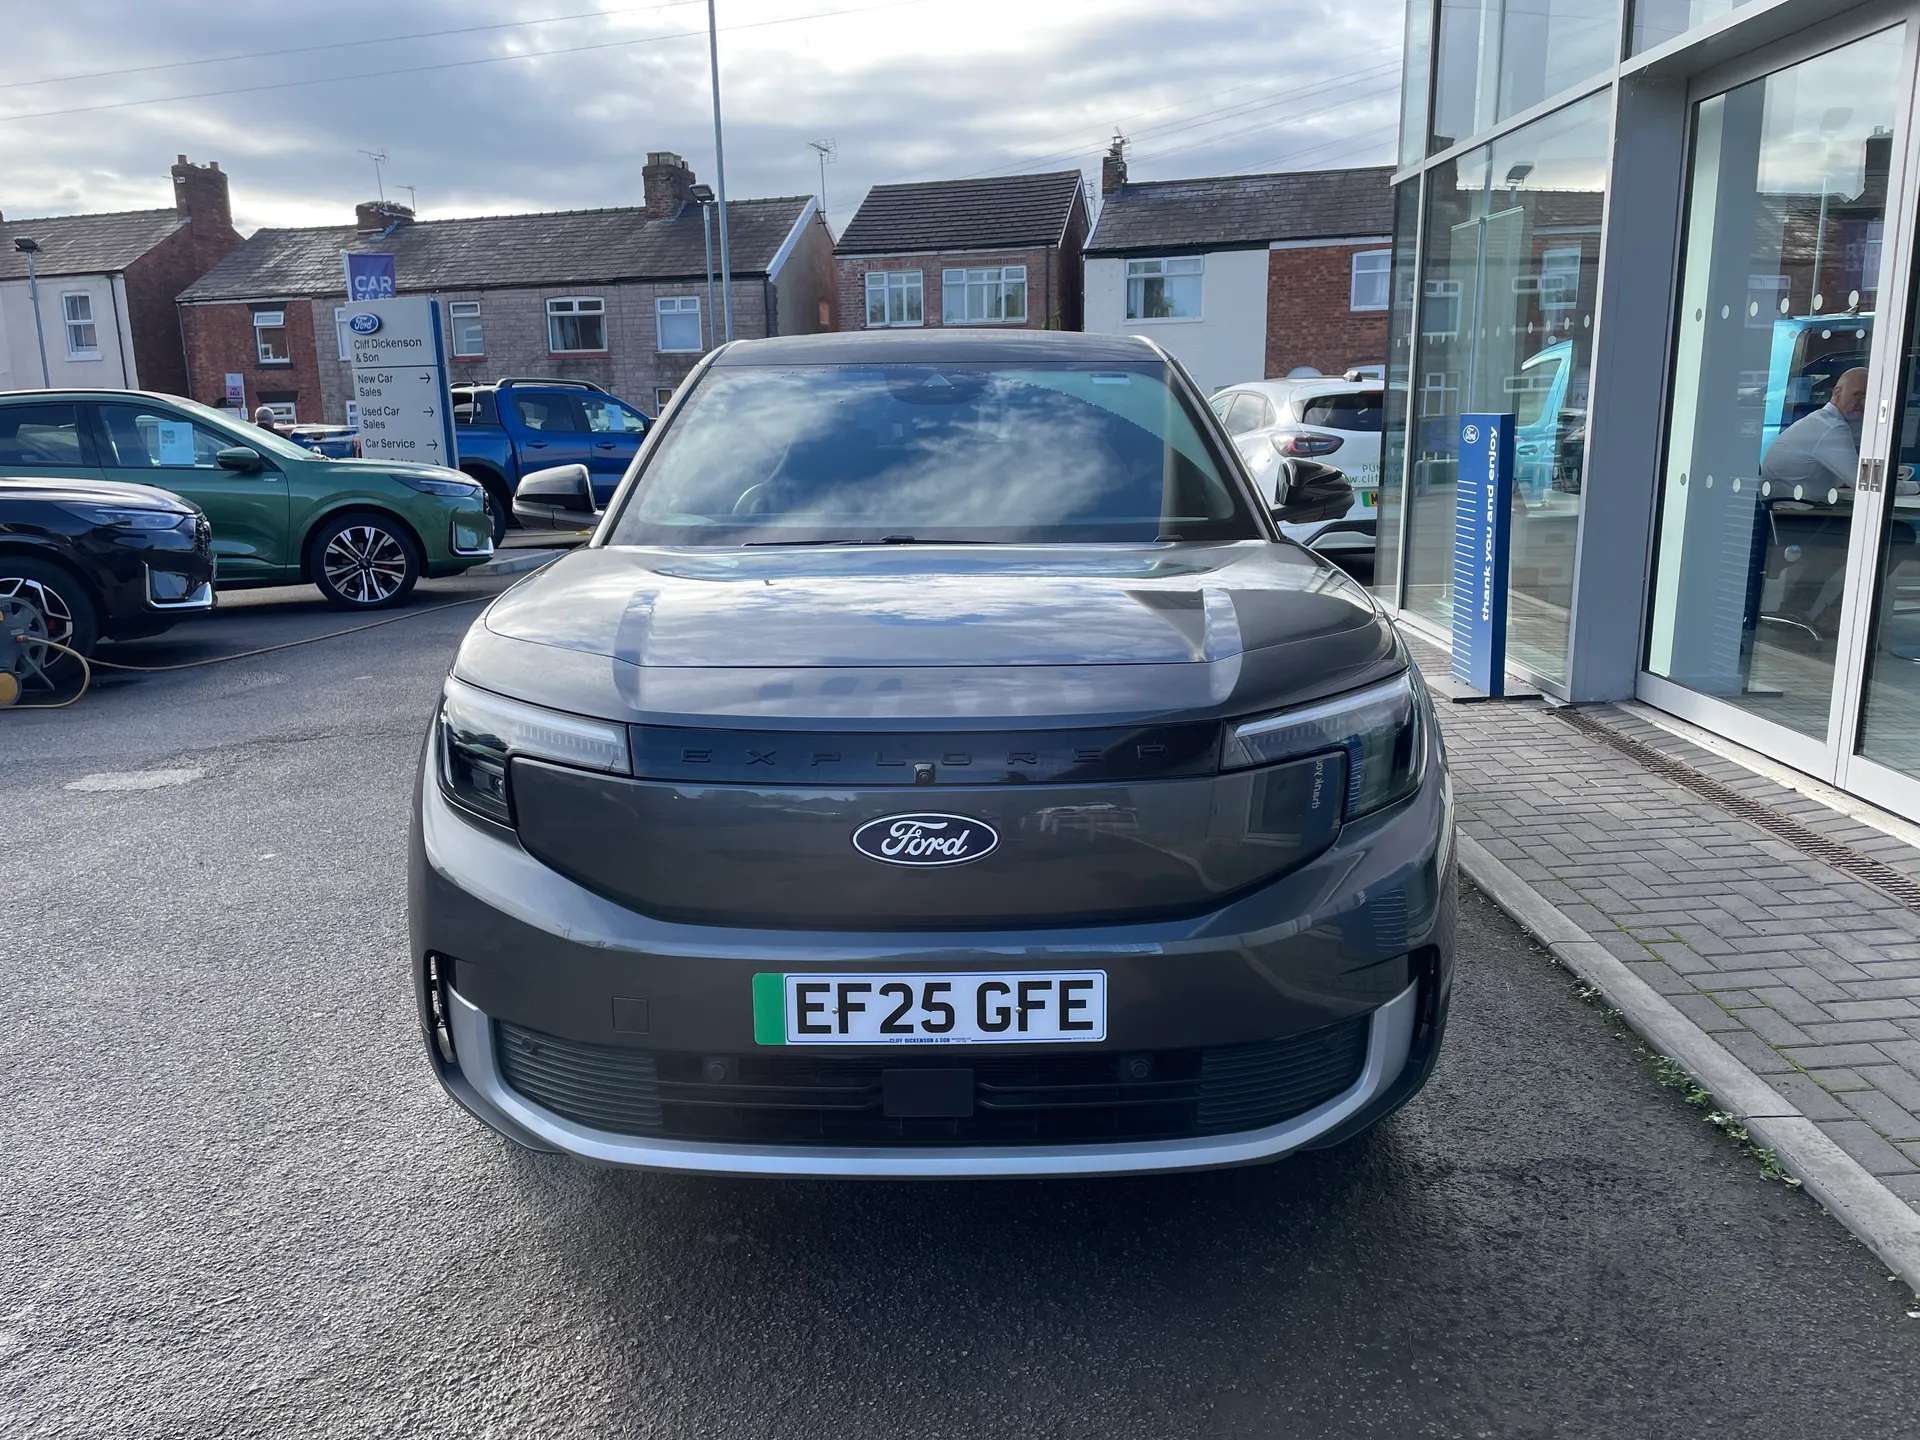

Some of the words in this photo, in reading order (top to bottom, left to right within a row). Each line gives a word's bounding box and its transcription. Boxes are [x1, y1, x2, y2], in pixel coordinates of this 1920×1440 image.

[354, 276, 392, 292] CAR
[354, 316, 373, 330] Ford
[354, 339, 370, 350] Cliff
[371, 337, 422, 349] Dickenson
[356, 355, 362, 363] &
[363, 353, 380, 363] Son
[358, 374, 376, 384] New
[377, 373, 393, 384] Car
[359, 387, 382, 397] Sales
[361, 407, 383, 417] Used
[384, 406, 400, 416] Car
[363, 419, 386, 429] Sales
[365, 438, 379, 449] Car
[380, 438, 416, 449] Service
[1488, 426, 1498, 481] enjoy
[1486, 484, 1494, 522] and
[1485, 526, 1493, 562] you
[1481, 566, 1492, 621] thank
[881, 820, 970, 856] Ford
[796, 982, 956, 1035] EF25
[976, 979, 1094, 1033] GFE
